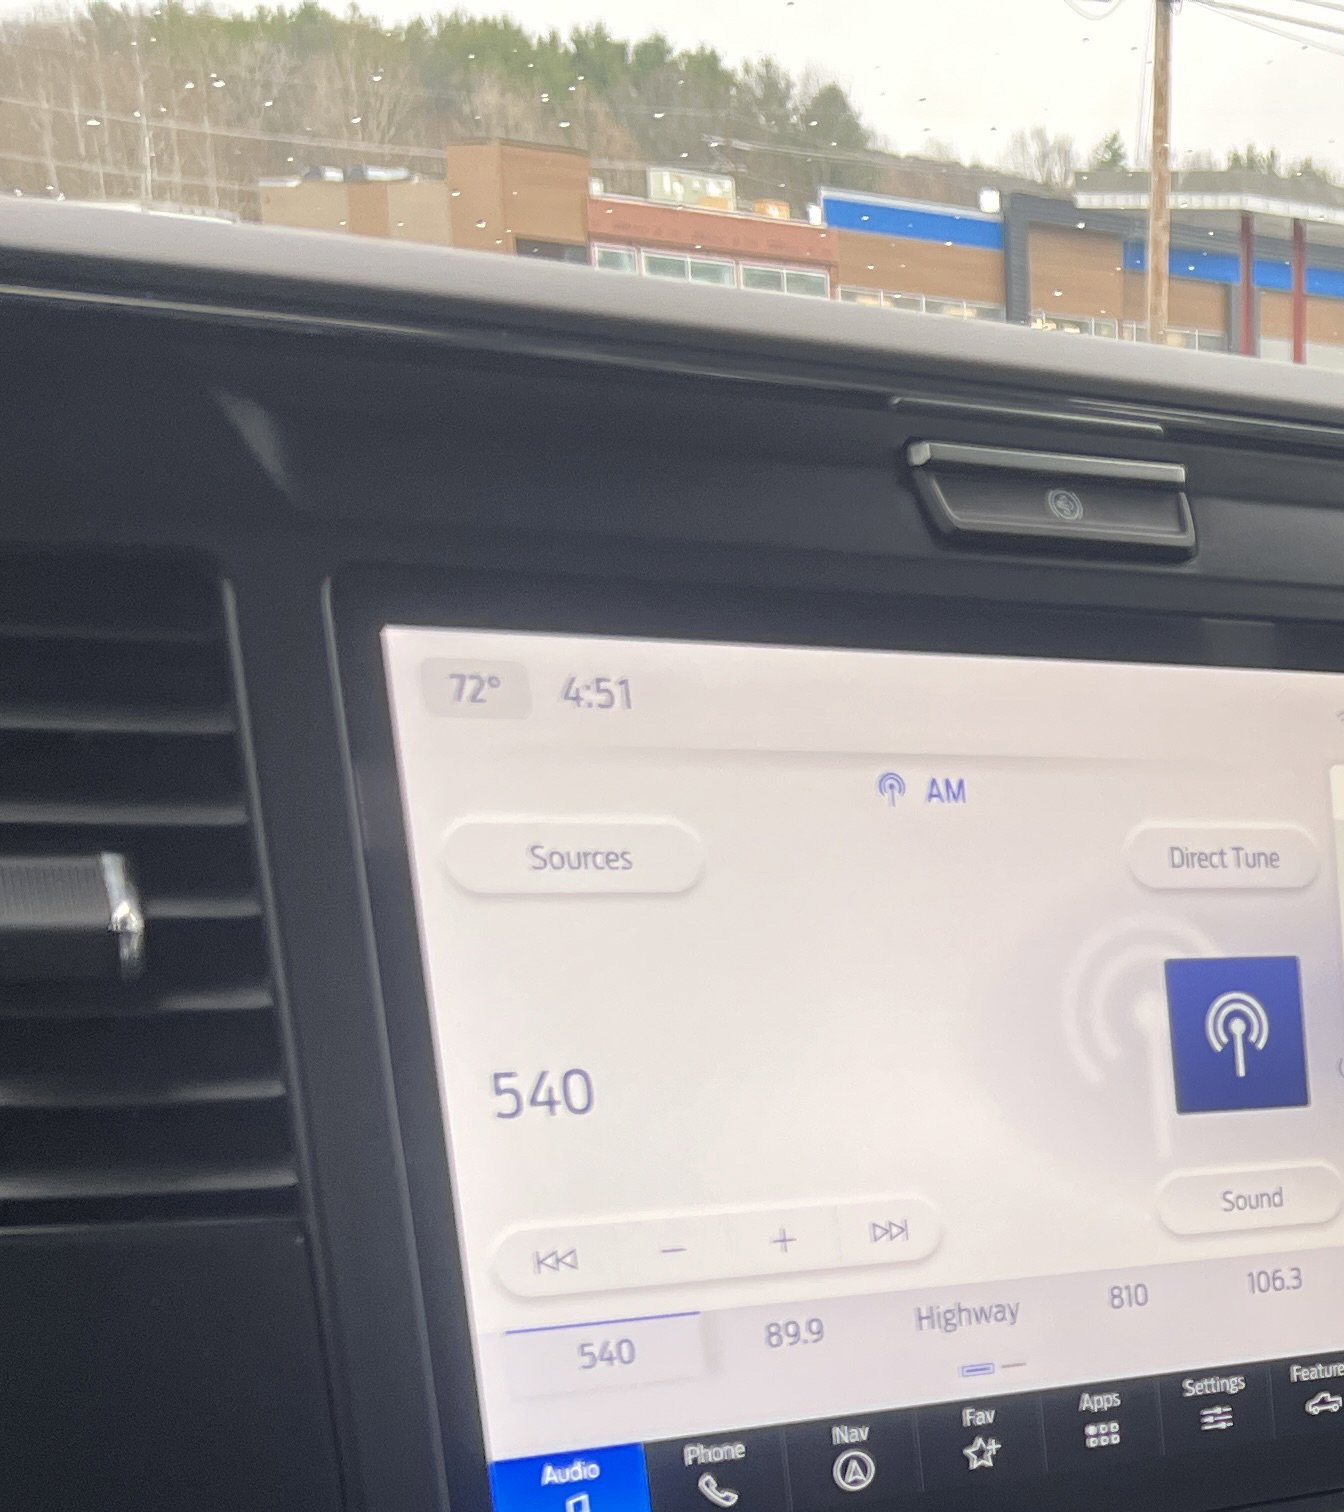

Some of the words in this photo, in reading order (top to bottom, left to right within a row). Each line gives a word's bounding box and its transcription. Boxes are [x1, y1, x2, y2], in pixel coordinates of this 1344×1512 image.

[448, 673, 500, 704] 72°
[560, 675, 632, 710] 4:51
[926, 778, 967, 805] AM
[530, 844, 633, 871] Sources
[1169, 845, 1227, 870] Direct
[1232, 847, 1280, 870] Tune
[491, 1067, 594, 1120] 540
[1221, 1186, 1284, 1212] Sound
[1246, 1266, 1304, 1295] 106.3
[1109, 1283, 1149, 1310] 810
[915, 1300, 1021, 1334] Highway
[765, 1317, 825, 1349] 89.9
[577, 1338, 636, 1370] 540
[1182, 1374, 1246, 1400] Settings
[1079, 1391, 1121, 1413] Apps
[961, 1407, 996, 1428] Fav
[831, 1424, 870, 1445] Nav
[684, 1440, 746, 1466] Phone
[541, 1460, 601, 1486] Audio
